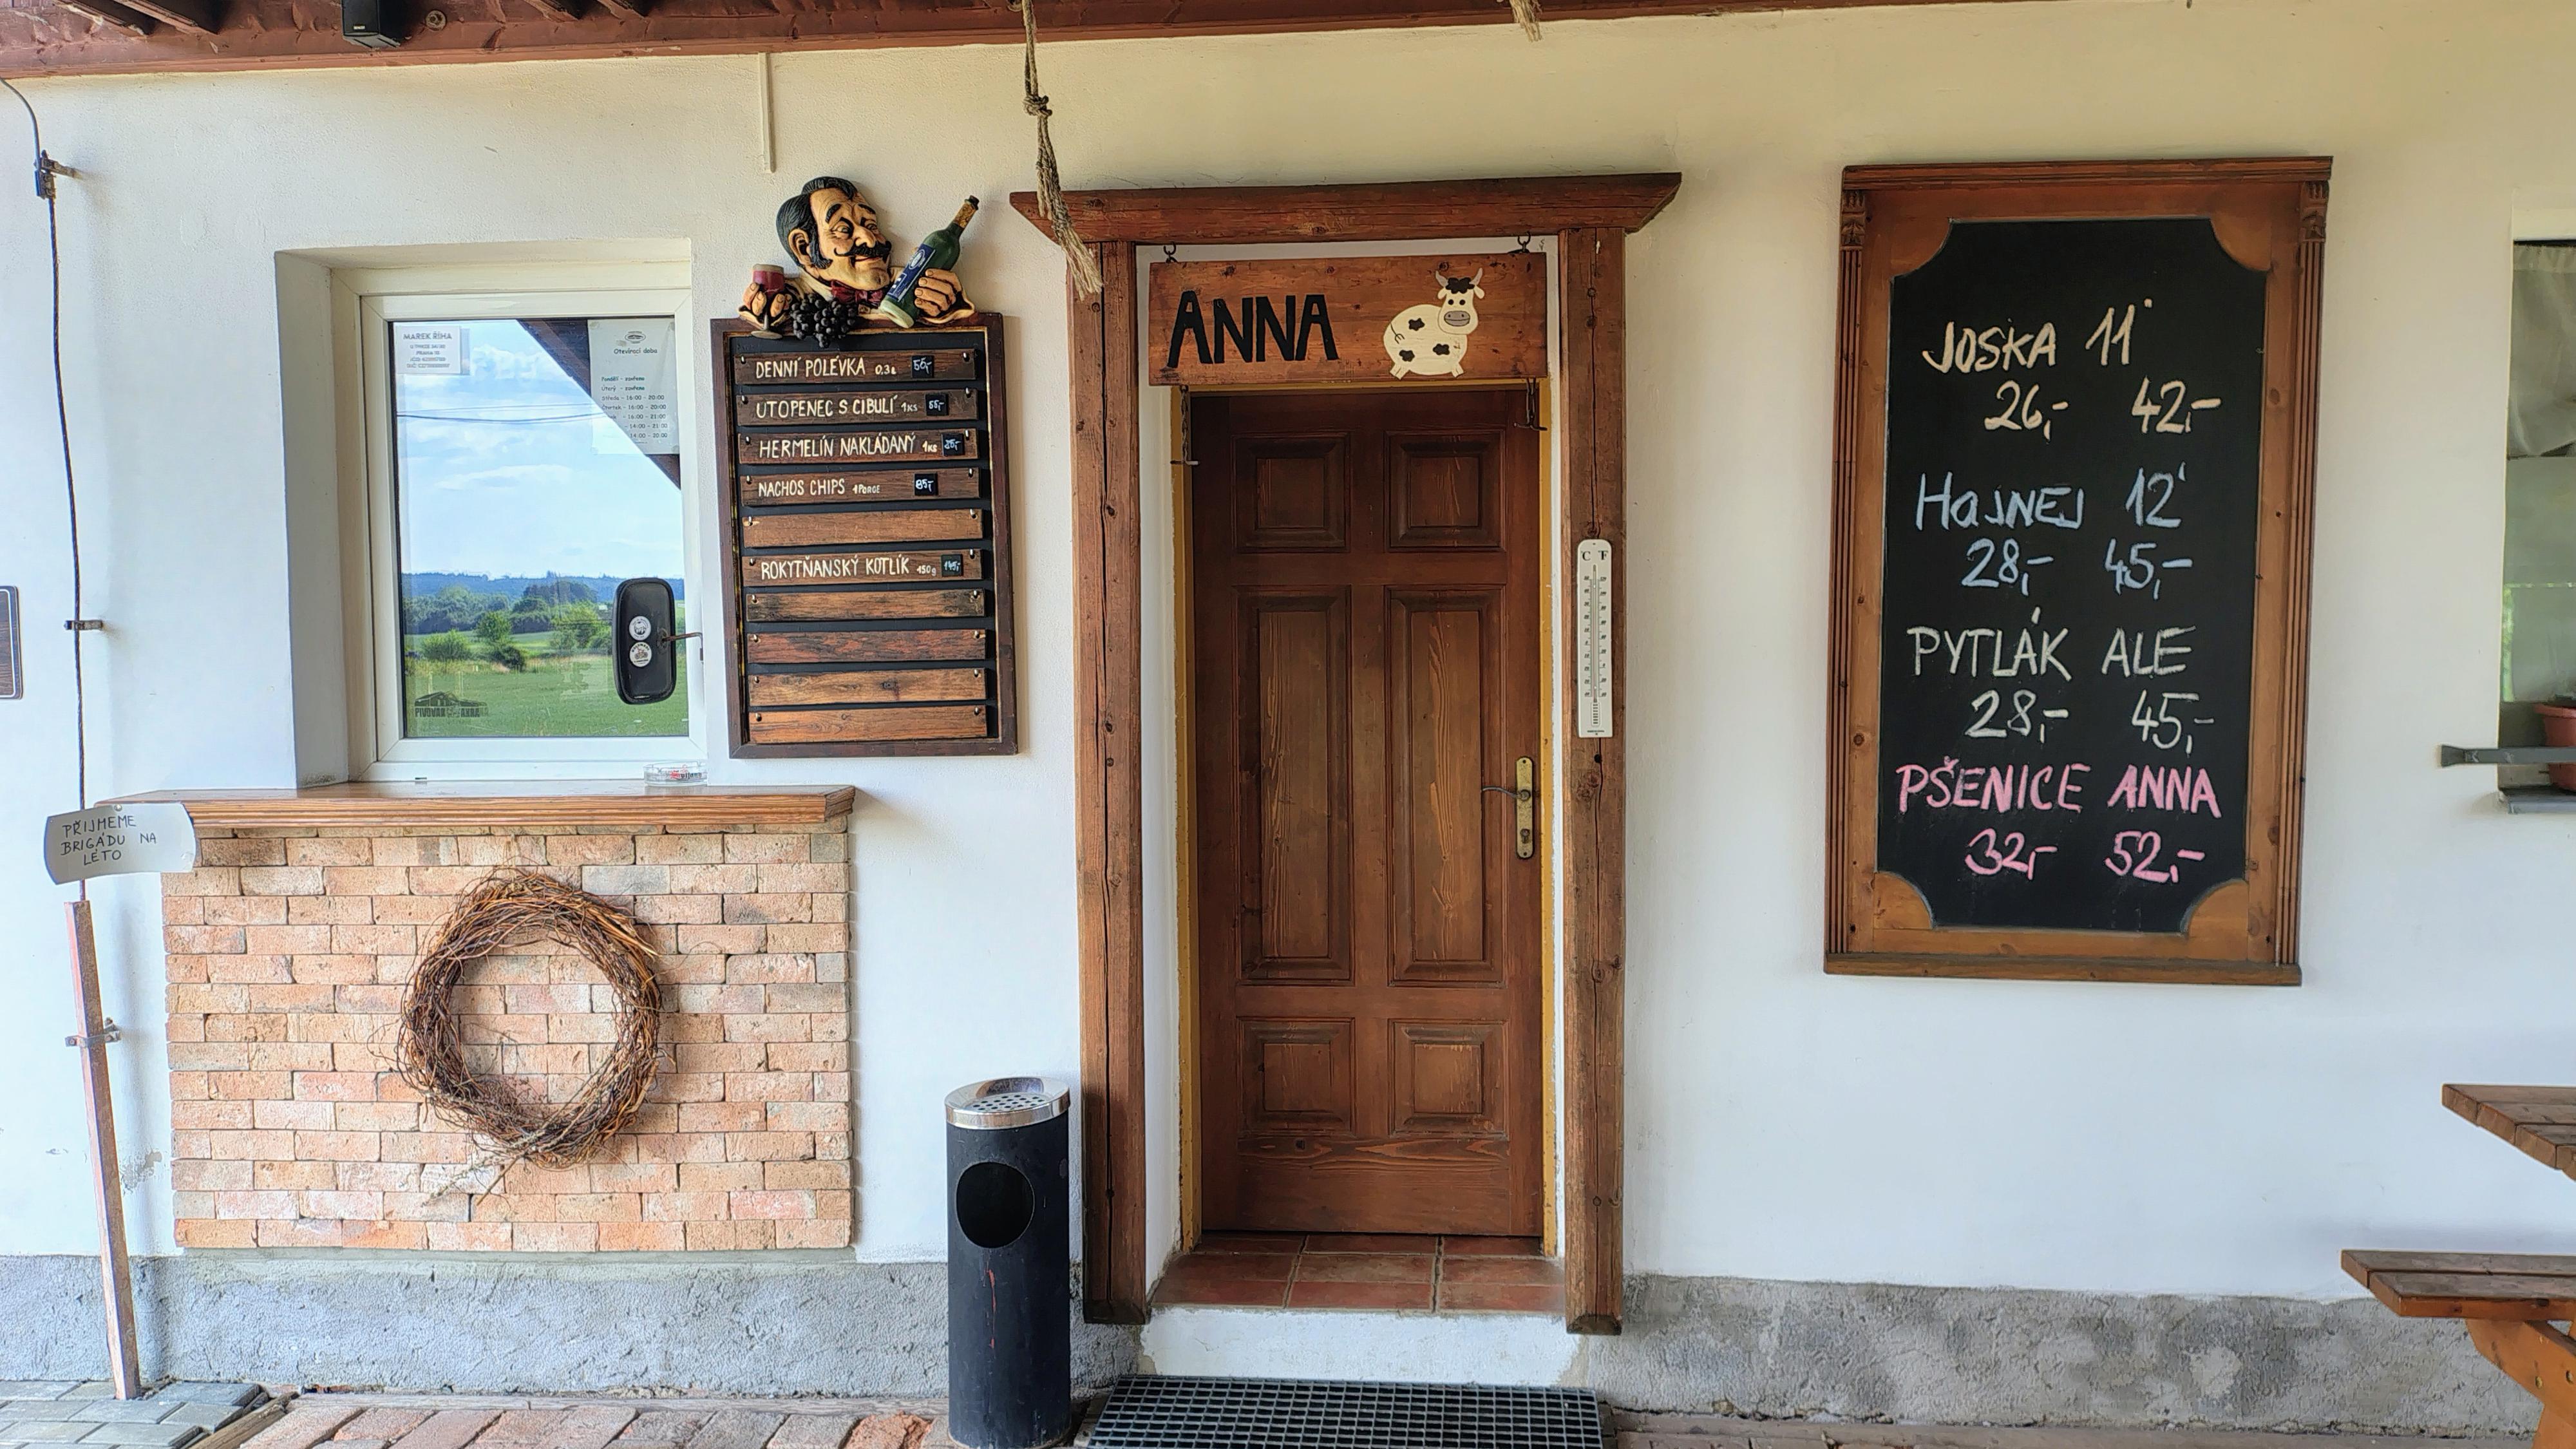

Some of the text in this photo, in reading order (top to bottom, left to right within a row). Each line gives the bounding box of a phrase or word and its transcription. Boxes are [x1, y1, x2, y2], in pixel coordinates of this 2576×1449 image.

[432, 330, 453, 340] ŘÍHA
[1166, 290, 1339, 369] ANNA
[1922, 321, 2056, 374] JOSKA
[756, 356, 802, 379] DENNÍ
[806, 356, 866, 377] POLÉVKA
[756, 400, 833, 418] UTOPENEC
[838, 401, 848, 415] S
[852, 394, 898, 415] CIBULÍ
[1984, 377, 2222, 441] 26,- 42,-
[759, 435, 834, 459] HERMELÍN
[840, 431, 916, 456] NAKLÁDANÝ
[759, 480, 804, 497] NACHOS
[810, 478, 846, 495] CHIPS
[761, 554, 860, 580] ROKYTŇANSKÝ
[866, 554, 909, 575] KOTLÍK
[1961, 538, 2193, 600] 28,- 45,-
[1907, 606, 2197, 681] PYTLÁK ALE
[1964, 688, 2214, 754] 28,- 45,-
[1896, 756, 2222, 819] PŠENICE ANNA
[62, 815, 137, 838] PŘIJMEME
[61, 832, 156, 856] BRIGÁDU NA
[84, 848, 122, 866] LÉTO
[1965, 828, 2206, 883] 32,- 52,-
